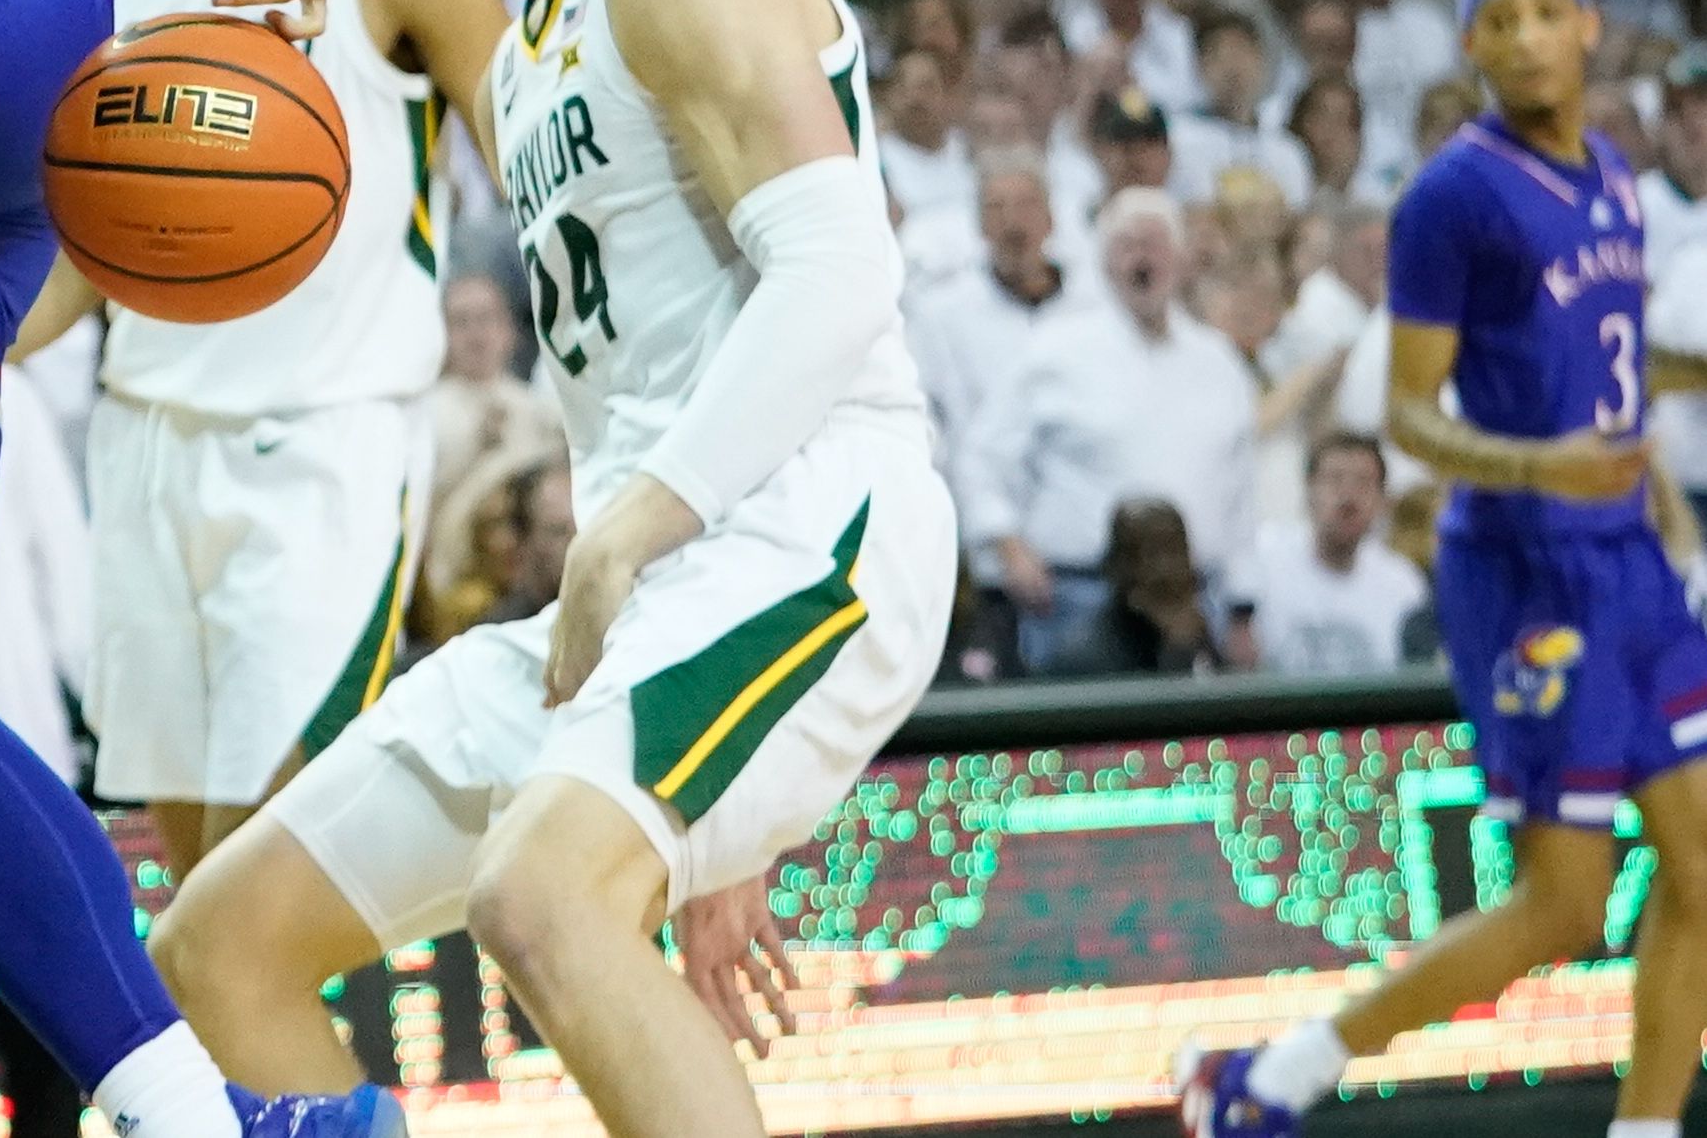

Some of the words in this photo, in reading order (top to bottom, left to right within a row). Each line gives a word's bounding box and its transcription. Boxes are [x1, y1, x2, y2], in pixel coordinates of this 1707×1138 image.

[94, 84, 258, 141] ELITE
[505, 94, 610, 230] AYLOR
[522, 214, 618, 378] 24
[1594, 311, 1640, 435] 3
